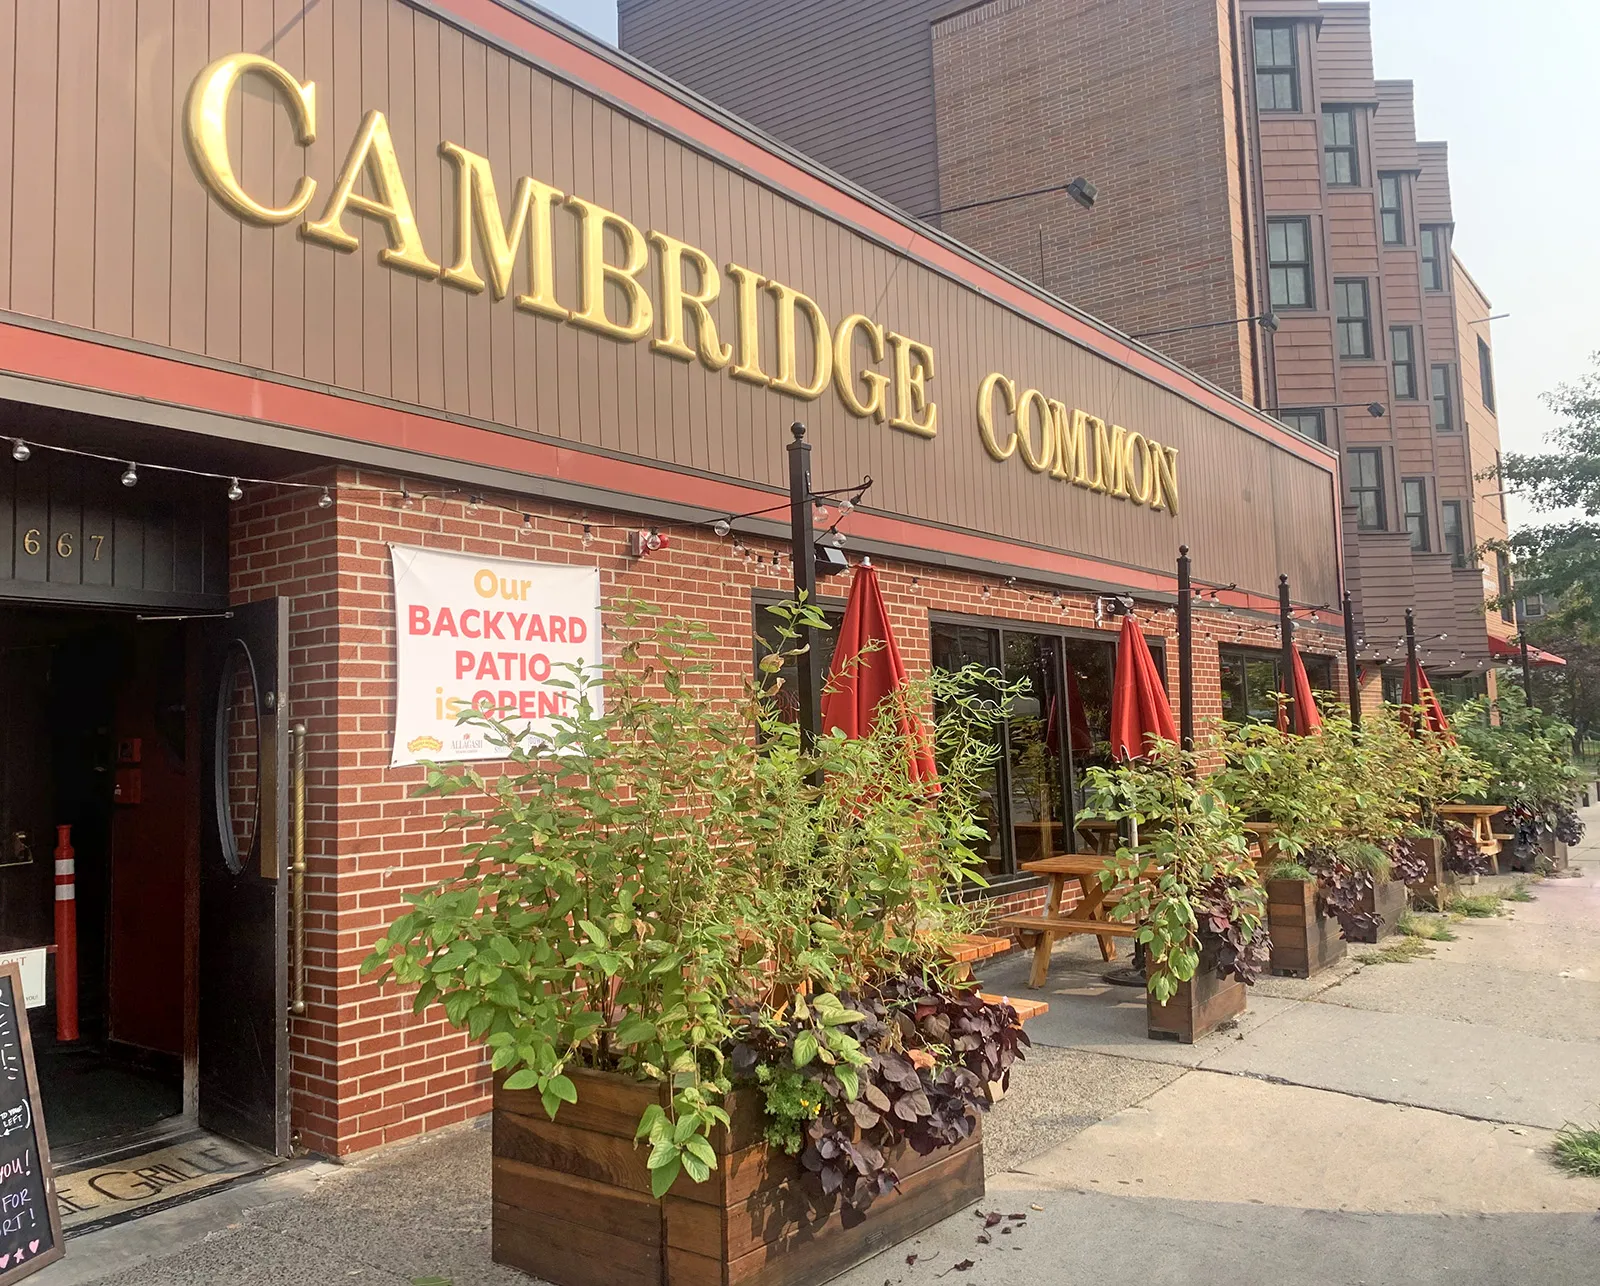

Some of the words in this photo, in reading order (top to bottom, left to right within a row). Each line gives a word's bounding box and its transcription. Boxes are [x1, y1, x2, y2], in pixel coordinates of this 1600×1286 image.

[185, 53, 938, 439] CAMBRIDGE
[977, 372, 1179, 517] COMMON
[24, 528, 105, 561] 667
[474, 568, 532, 601] Our
[408, 604, 588, 644] BACKYARD
[455, 650, 551, 682] PATIO
[435, 686, 461, 721] is
[471, 689, 569, 720] OPEN!
[2, 1188, 32, 1213] FOR
[0, 1208, 36, 1236] RT!
